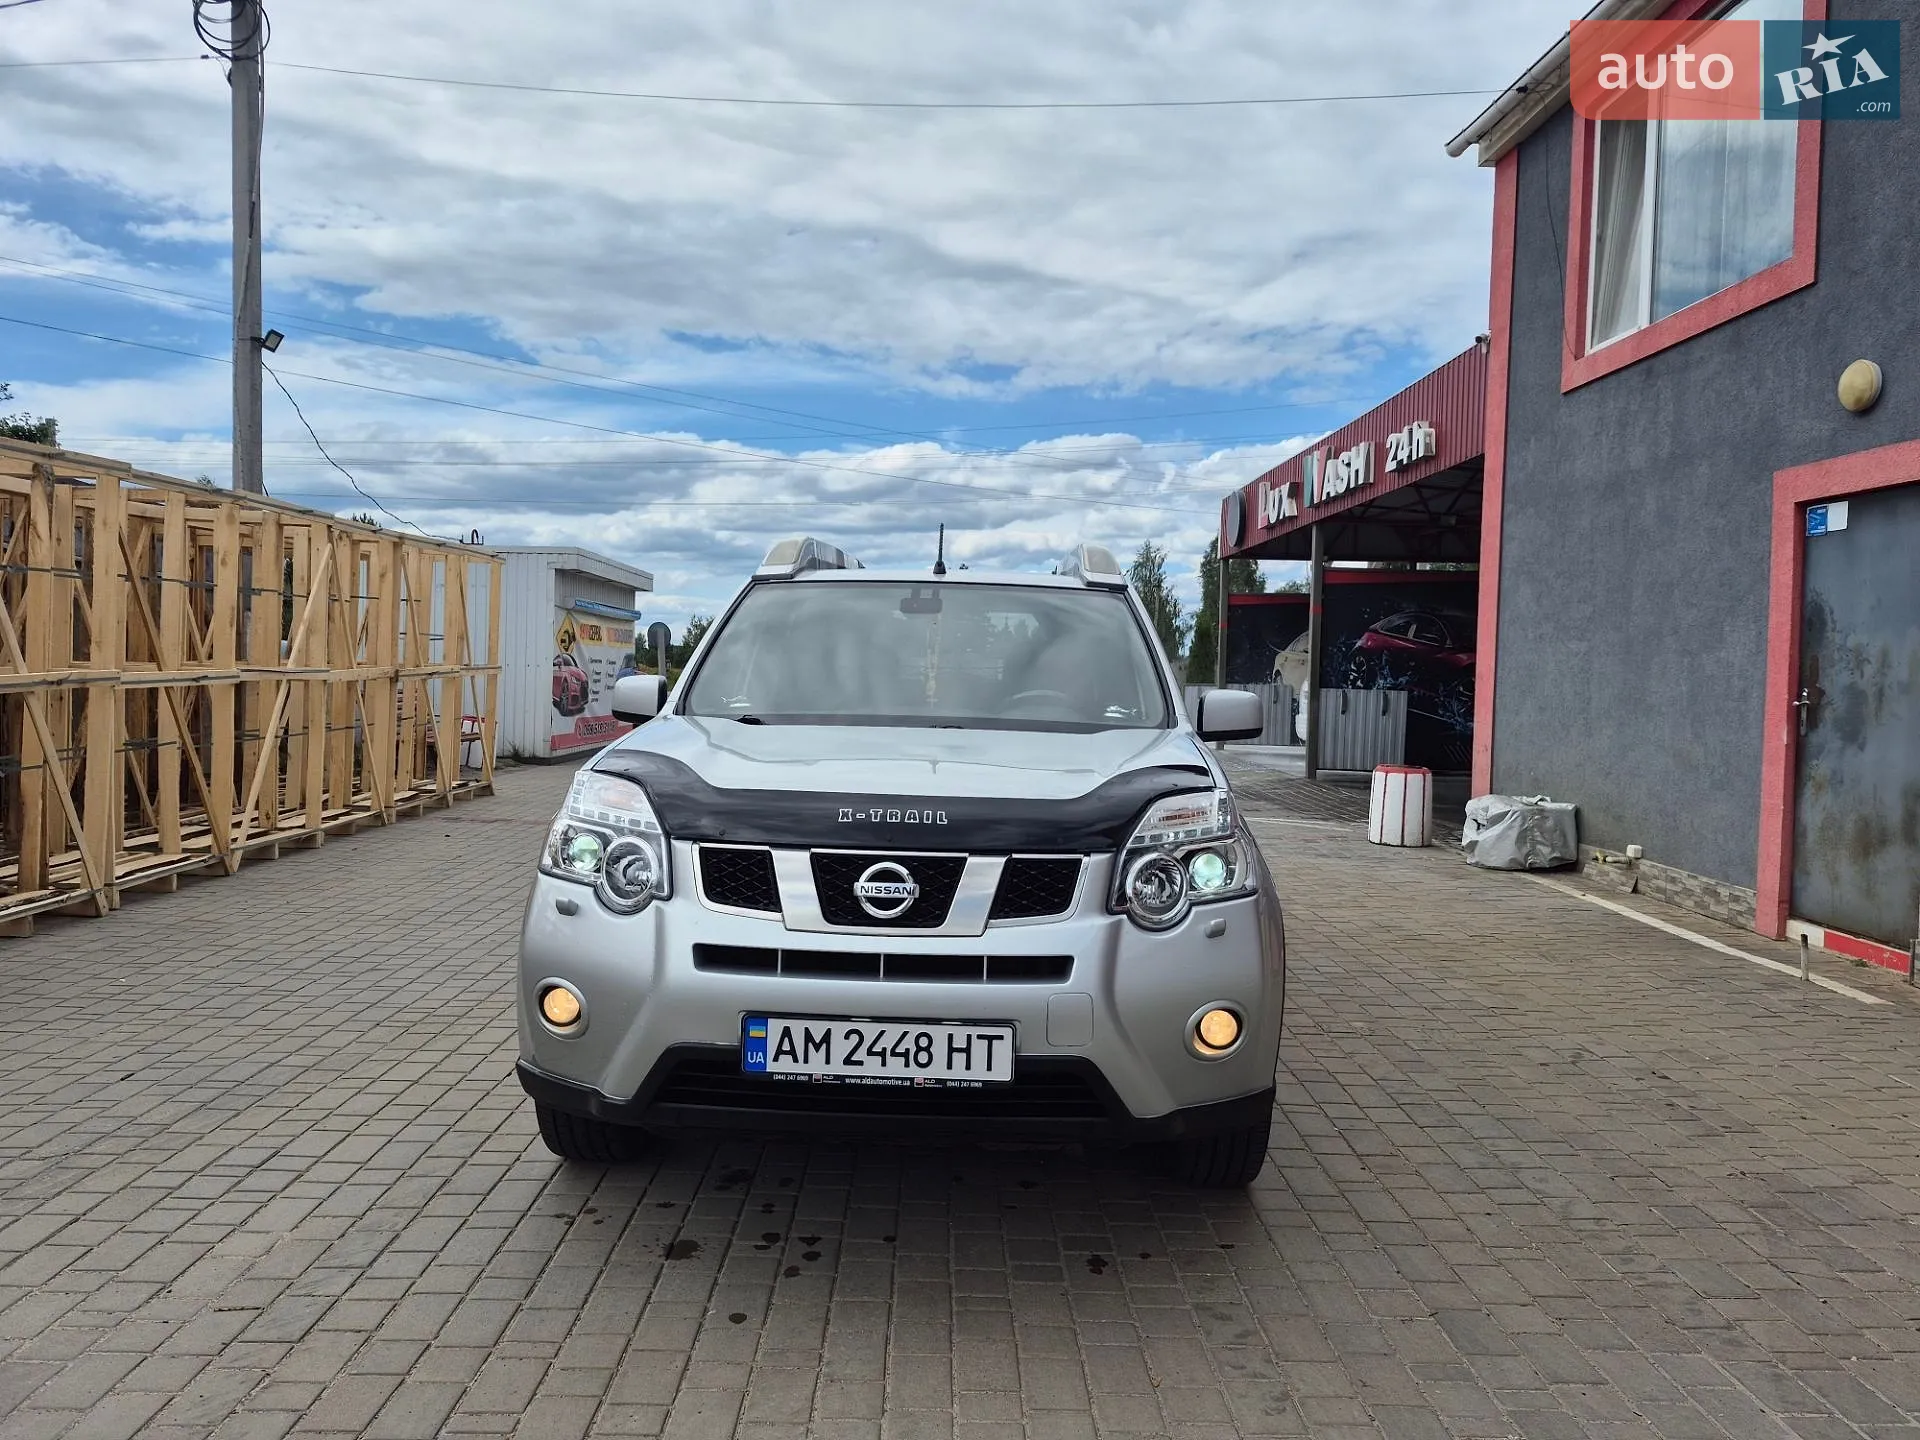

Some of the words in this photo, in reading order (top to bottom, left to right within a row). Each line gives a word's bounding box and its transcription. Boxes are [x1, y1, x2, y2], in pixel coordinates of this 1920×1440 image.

[838, 808, 948, 825] X-TRAIL
[860, 885, 912, 895] NISSAN
[772, 1026, 832, 1065] AM
[842, 1028, 933, 1069] 2448
[946, 1032, 1004, 1072] HT
[747, 1051, 765, 1064] UA
[845, 1077, 910, 1086] www.aldautomotive.ua
